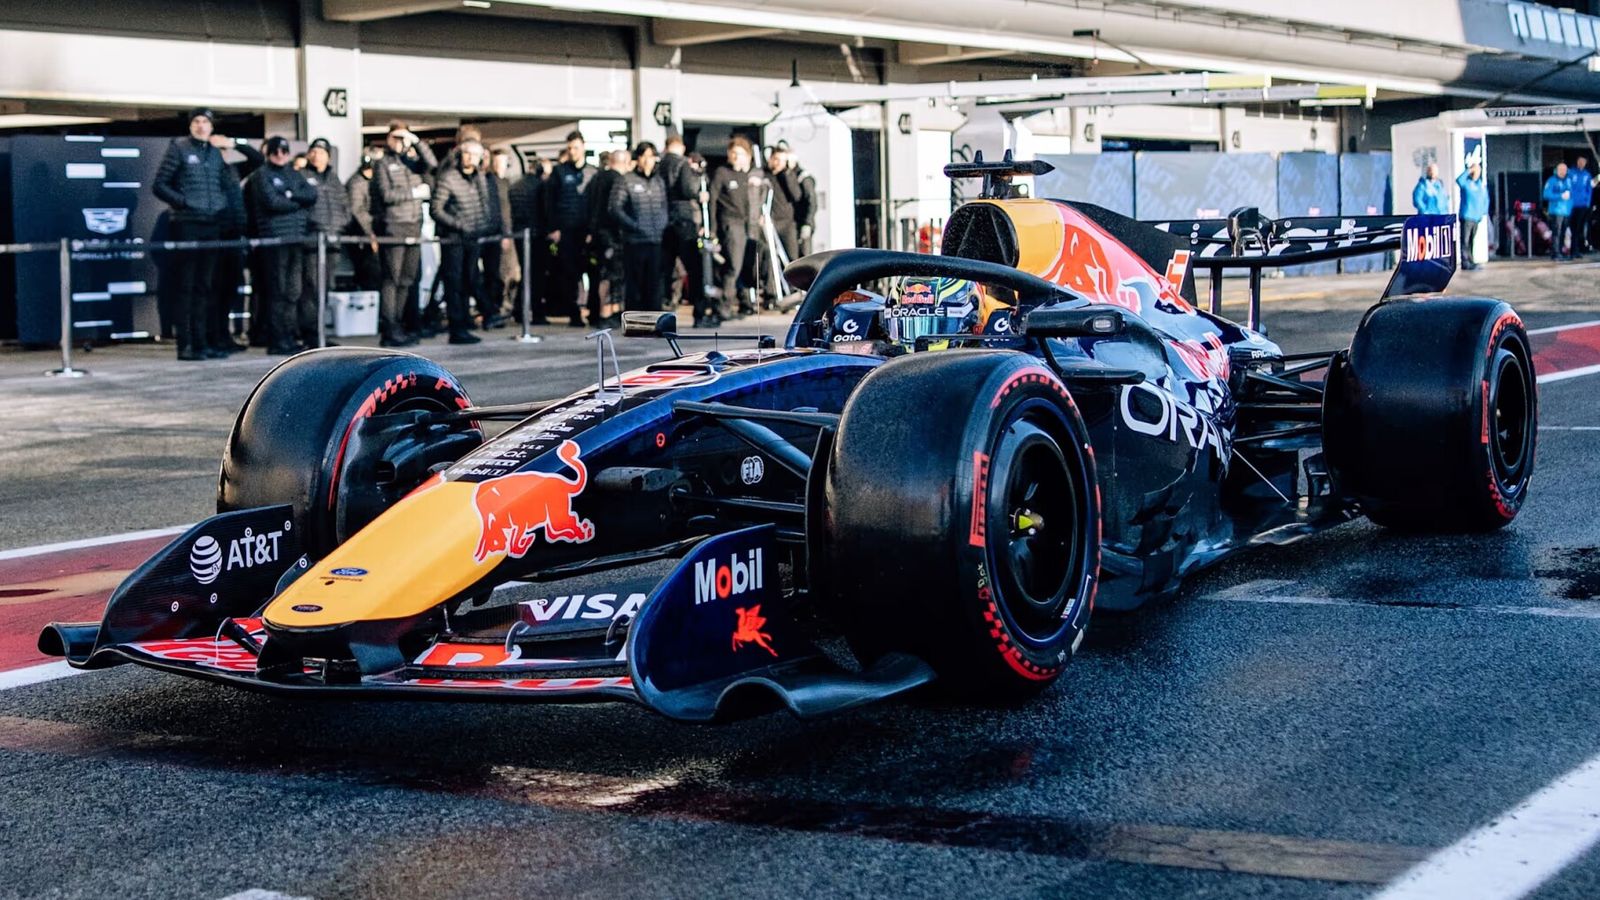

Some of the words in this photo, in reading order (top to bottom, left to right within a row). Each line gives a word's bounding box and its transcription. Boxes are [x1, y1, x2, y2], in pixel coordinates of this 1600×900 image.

[327, 91, 346, 114] 46
[1406, 225, 1440, 262] Mobil
[892, 307, 945, 317] ORACLE
[833, 334, 862, 343] Gate
[449, 466, 490, 476] Mobil
[741, 460, 762, 481] FIA
[226, 530, 283, 571] AT&T
[694, 547, 763, 605] Mobil
[519, 593, 648, 622] VISA
